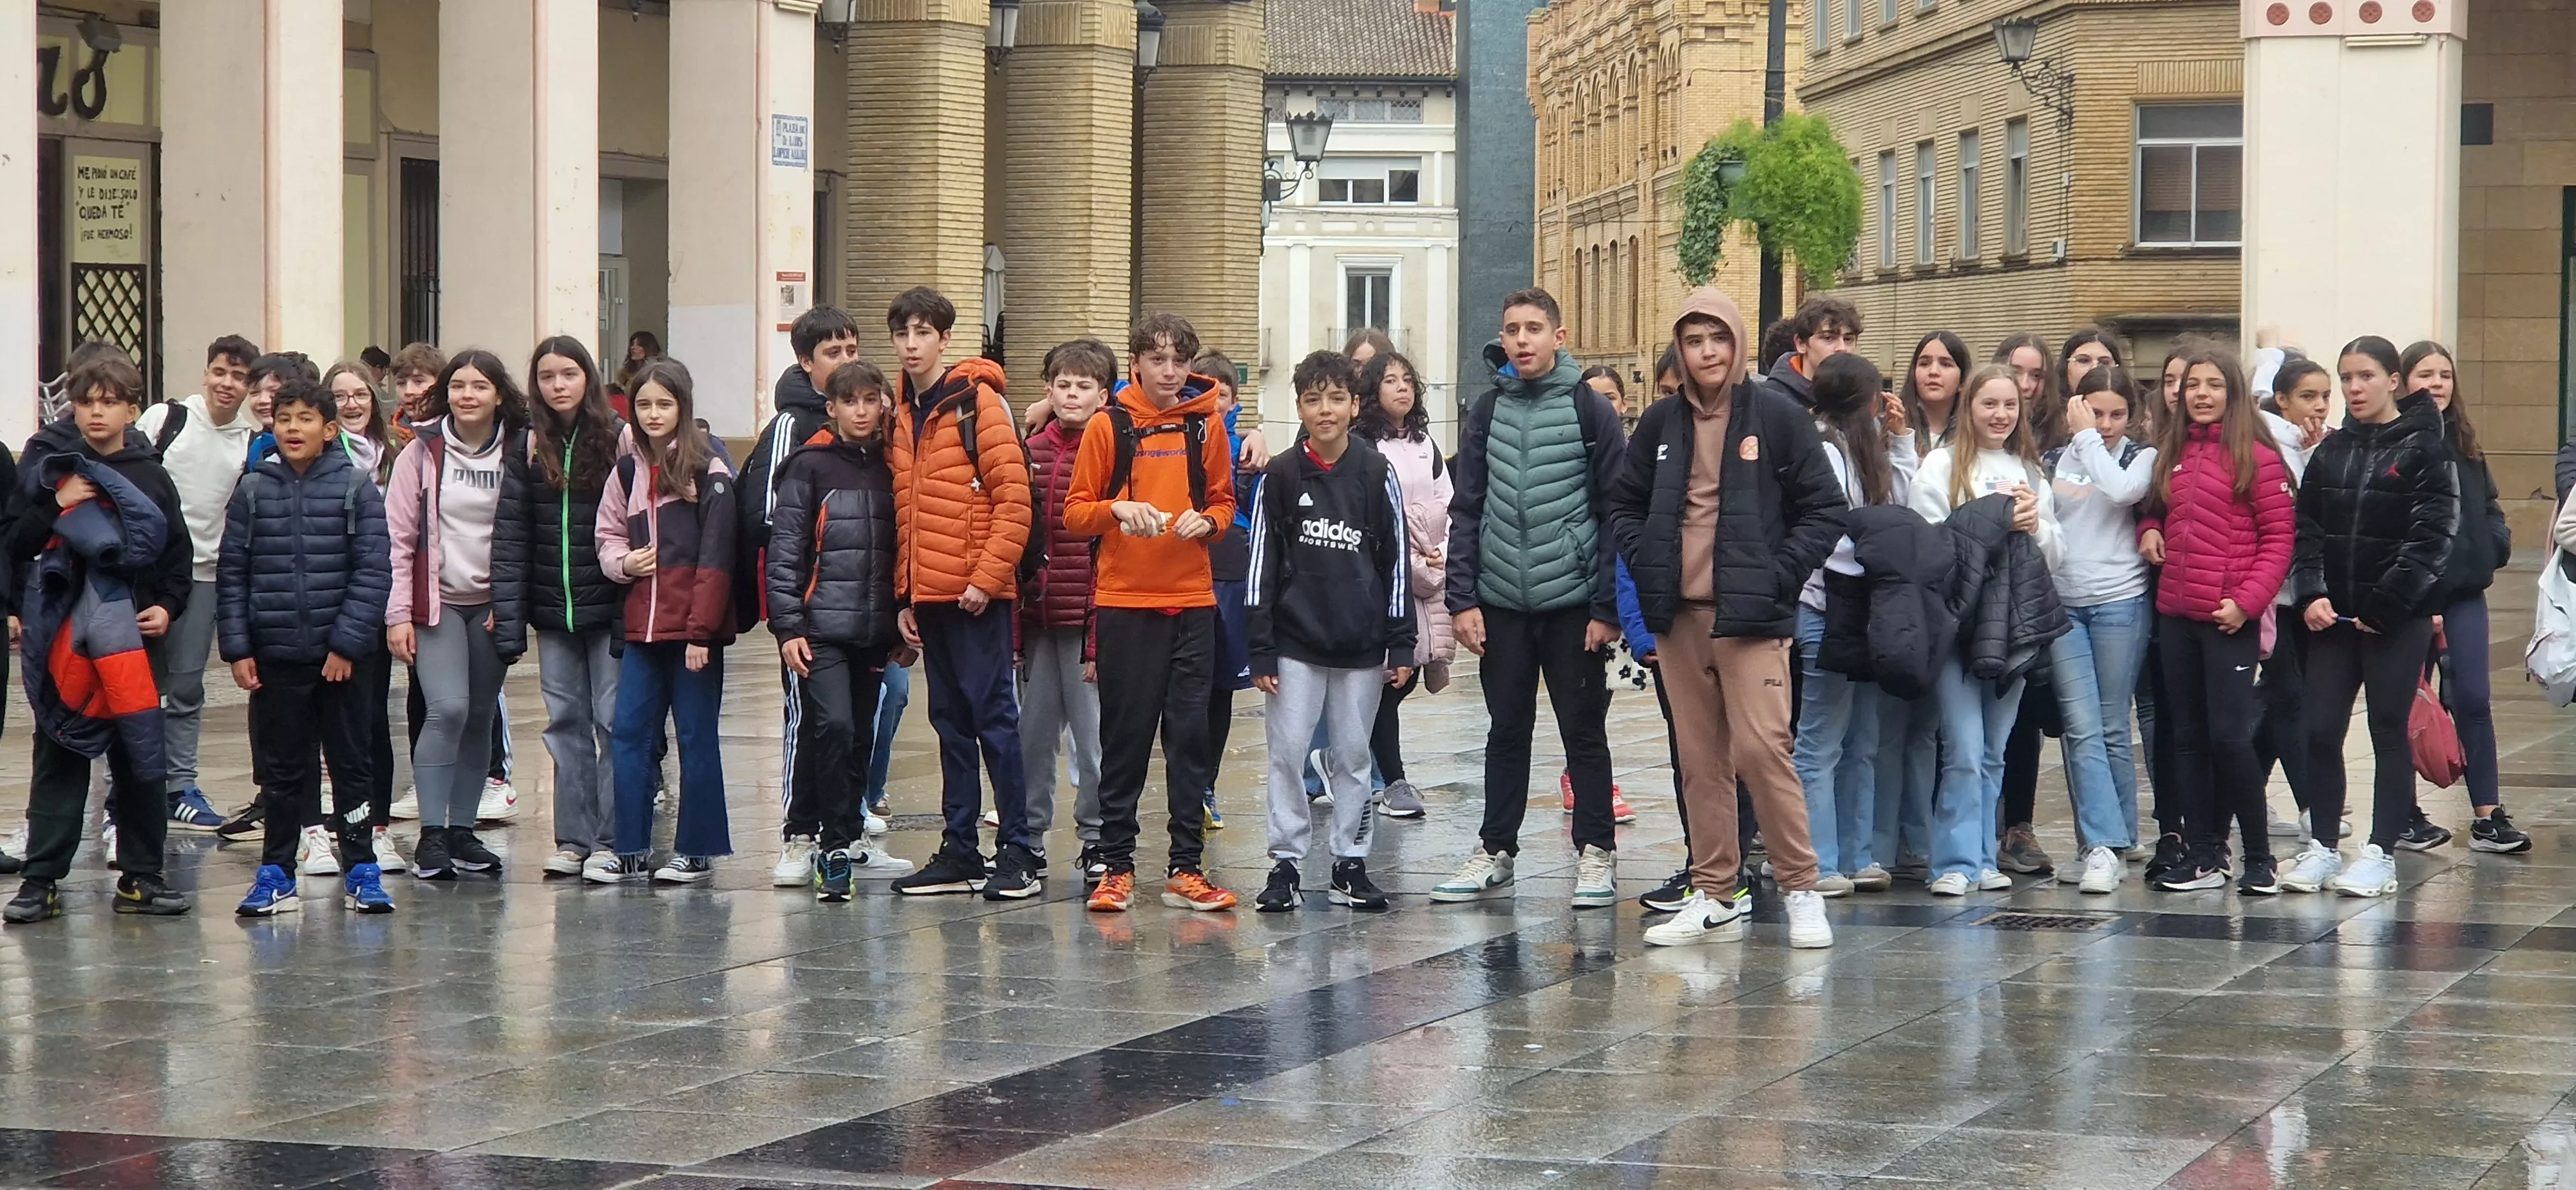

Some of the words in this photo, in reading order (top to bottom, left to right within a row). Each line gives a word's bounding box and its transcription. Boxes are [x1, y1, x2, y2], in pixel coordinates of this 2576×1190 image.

[77, 166, 90, 180] ME
[118, 165, 137, 180] CAFÉ
[78, 186, 84, 199] Y
[87, 187, 95, 198] LE
[1302, 517, 1363, 545] adidas
